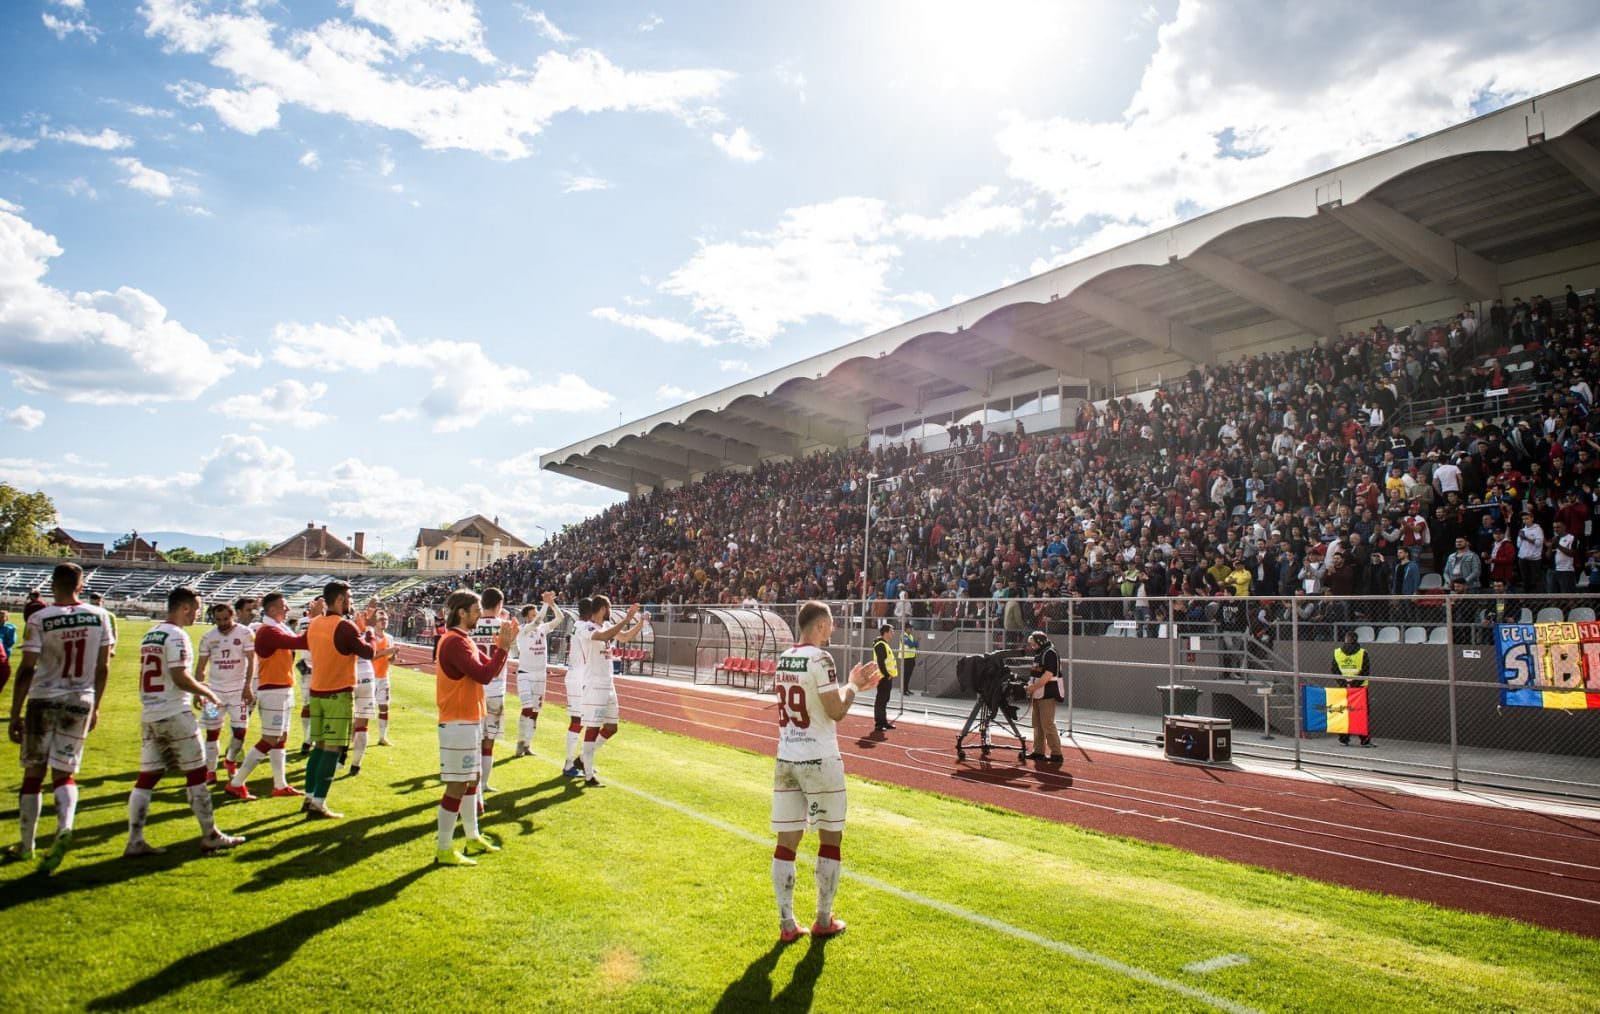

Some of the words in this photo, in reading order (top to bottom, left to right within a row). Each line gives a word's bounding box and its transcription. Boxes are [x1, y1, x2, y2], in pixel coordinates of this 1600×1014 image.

[77, 614, 97, 624] bet
[1502, 623, 1577, 641] PELUZA
[62, 639, 86, 678] 11
[221, 649, 230, 659] 17
[141, 655, 165, 693] 2
